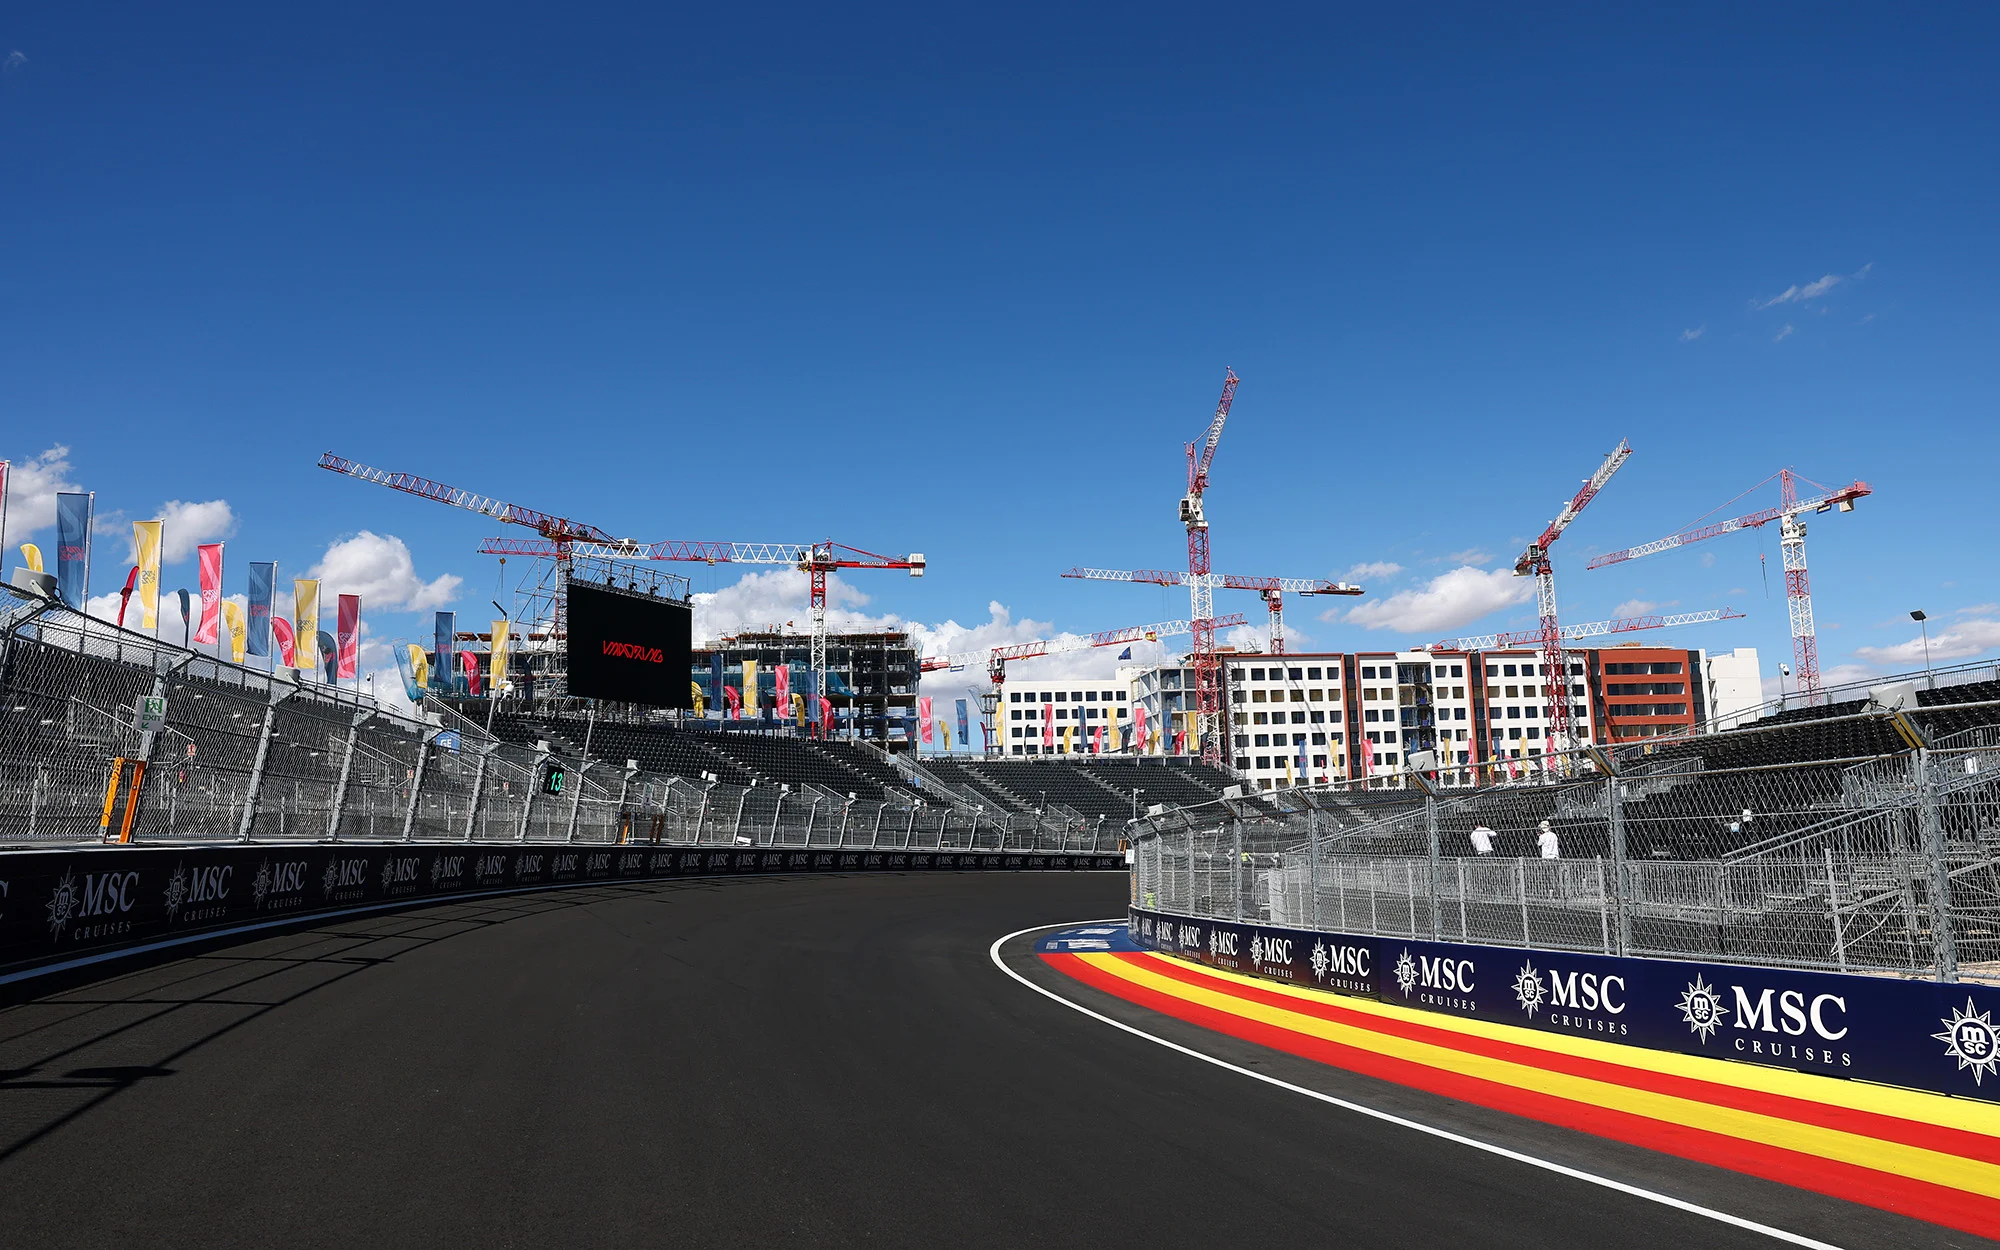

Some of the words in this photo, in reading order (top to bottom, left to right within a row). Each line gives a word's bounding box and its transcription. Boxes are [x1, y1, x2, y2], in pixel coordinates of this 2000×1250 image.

[142, 714, 162, 722] EXIT
[550, 772, 563, 791] 13
[393, 857, 420, 882] MSC
[442, 856, 465, 877] MSC
[485, 855, 507, 875] MSC
[522, 855, 544, 873] MSC
[560, 854, 579, 871] MSC
[594, 853, 611, 869] MSC
[626, 853, 643, 868] MSC
[657, 854, 673, 867] MSC
[686, 854, 702, 867] MSC
[270, 861, 308, 893] MSC
[337, 859, 368, 886] MSC
[187, 865, 233, 903] MSC
[391, 885, 416, 894] CRUISES
[78, 872, 140, 917] MSC
[267, 897, 303, 909] CRUISES
[334, 890, 364, 900] CRUISES
[184, 906, 226, 922] CRUISES
[74, 921, 131, 940] CRUISES
[1185, 925, 1200, 948] MSC
[1218, 931, 1238, 956] MSC
[1264, 937, 1292, 965] MSC
[1217, 957, 1238, 968] CRUISES
[1330, 945, 1370, 977] MSC
[1264, 966, 1292, 979] CRUISES
[1420, 955, 1475, 993] MSC
[1330, 978, 1371, 992] CRUISES
[1549, 969, 1626, 1014] MSC
[1421, 993, 1476, 1011] CRUISES
[1731, 985, 1848, 1041] MSC
[1551, 1013, 1628, 1035] CRUISES
[1735, 1038, 1852, 1067] CRUISES
